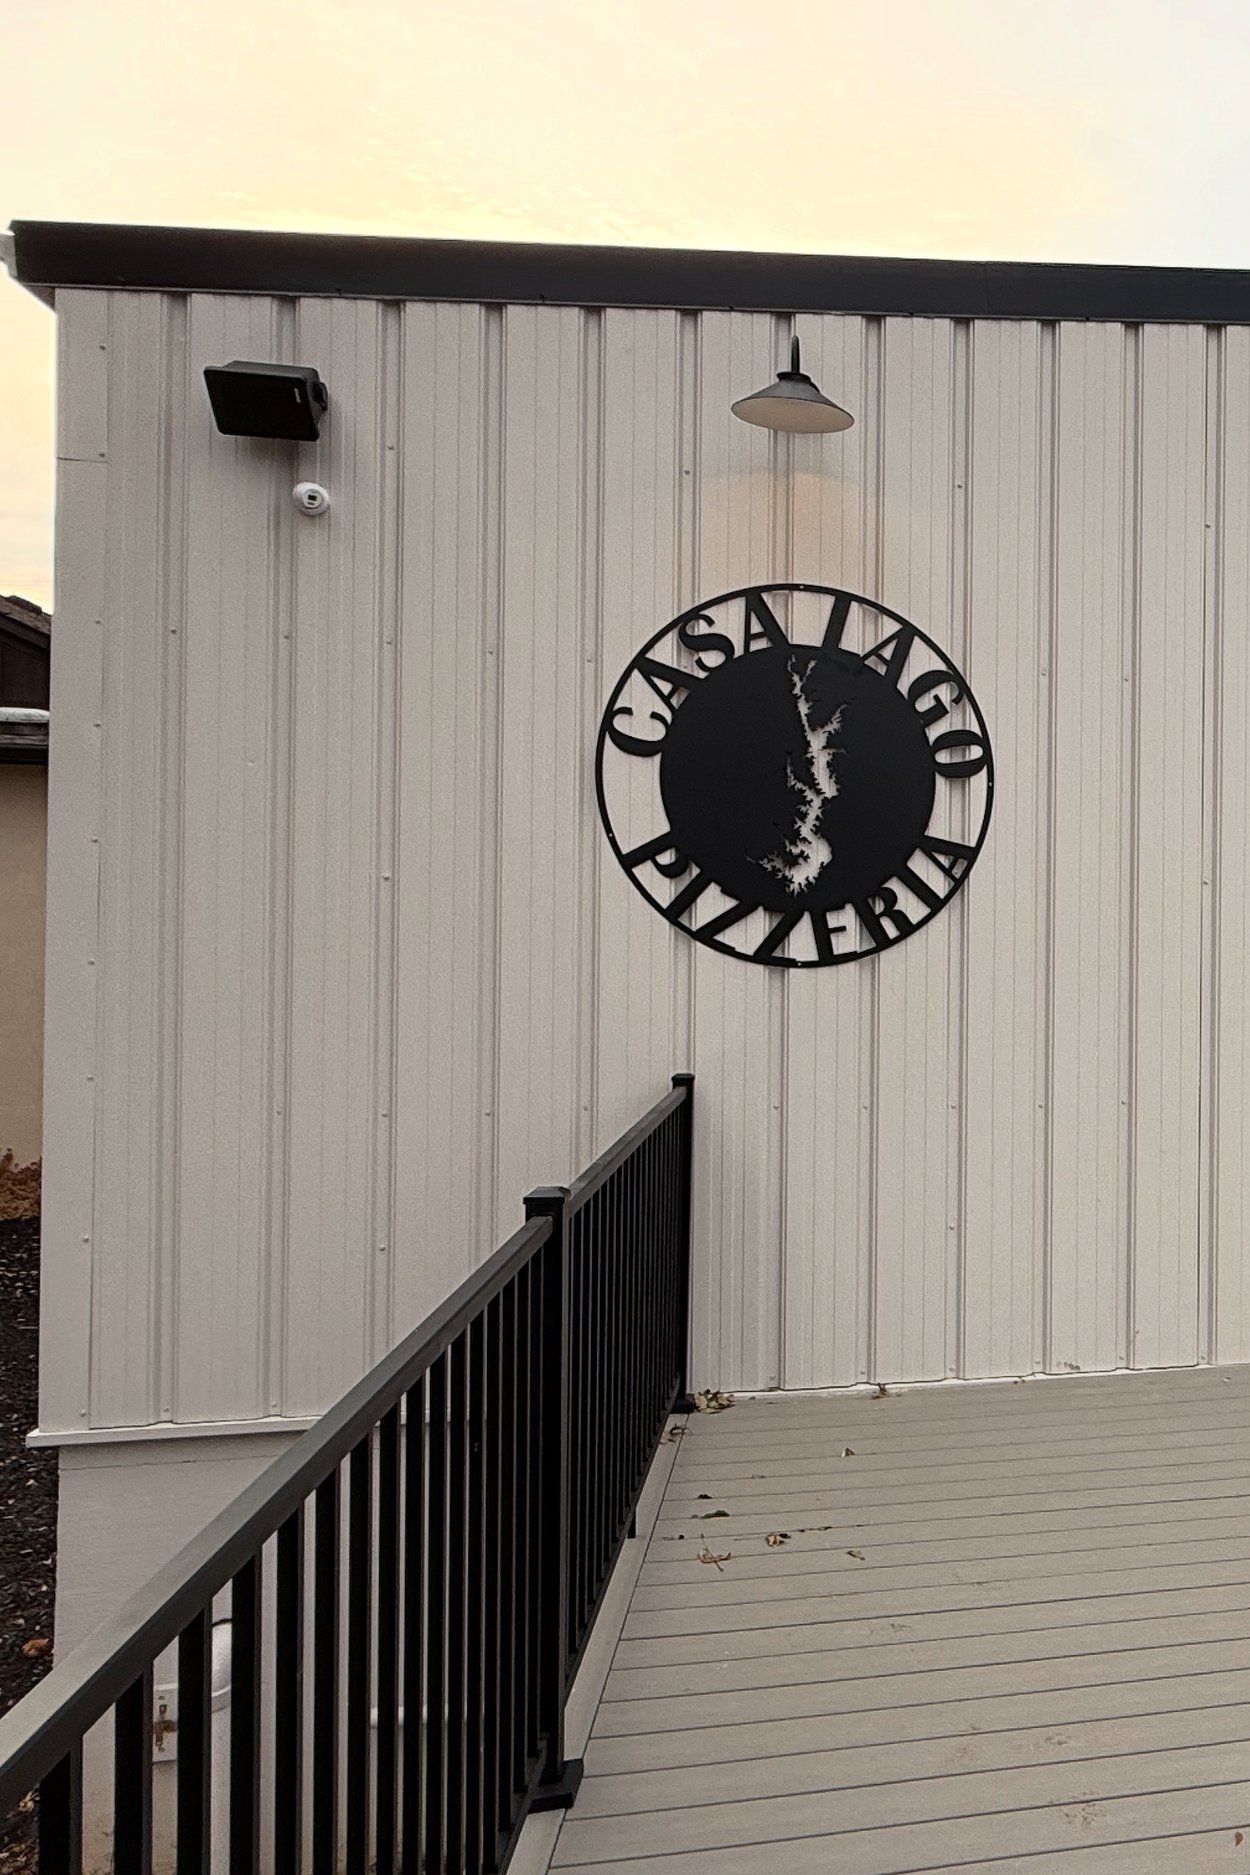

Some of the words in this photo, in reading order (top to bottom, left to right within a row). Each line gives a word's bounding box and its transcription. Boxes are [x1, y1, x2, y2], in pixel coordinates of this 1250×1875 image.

[606, 590, 791, 758] CASA
[821, 592, 989, 779] LAGO
[620, 831, 978, 960] PIZZERIA
